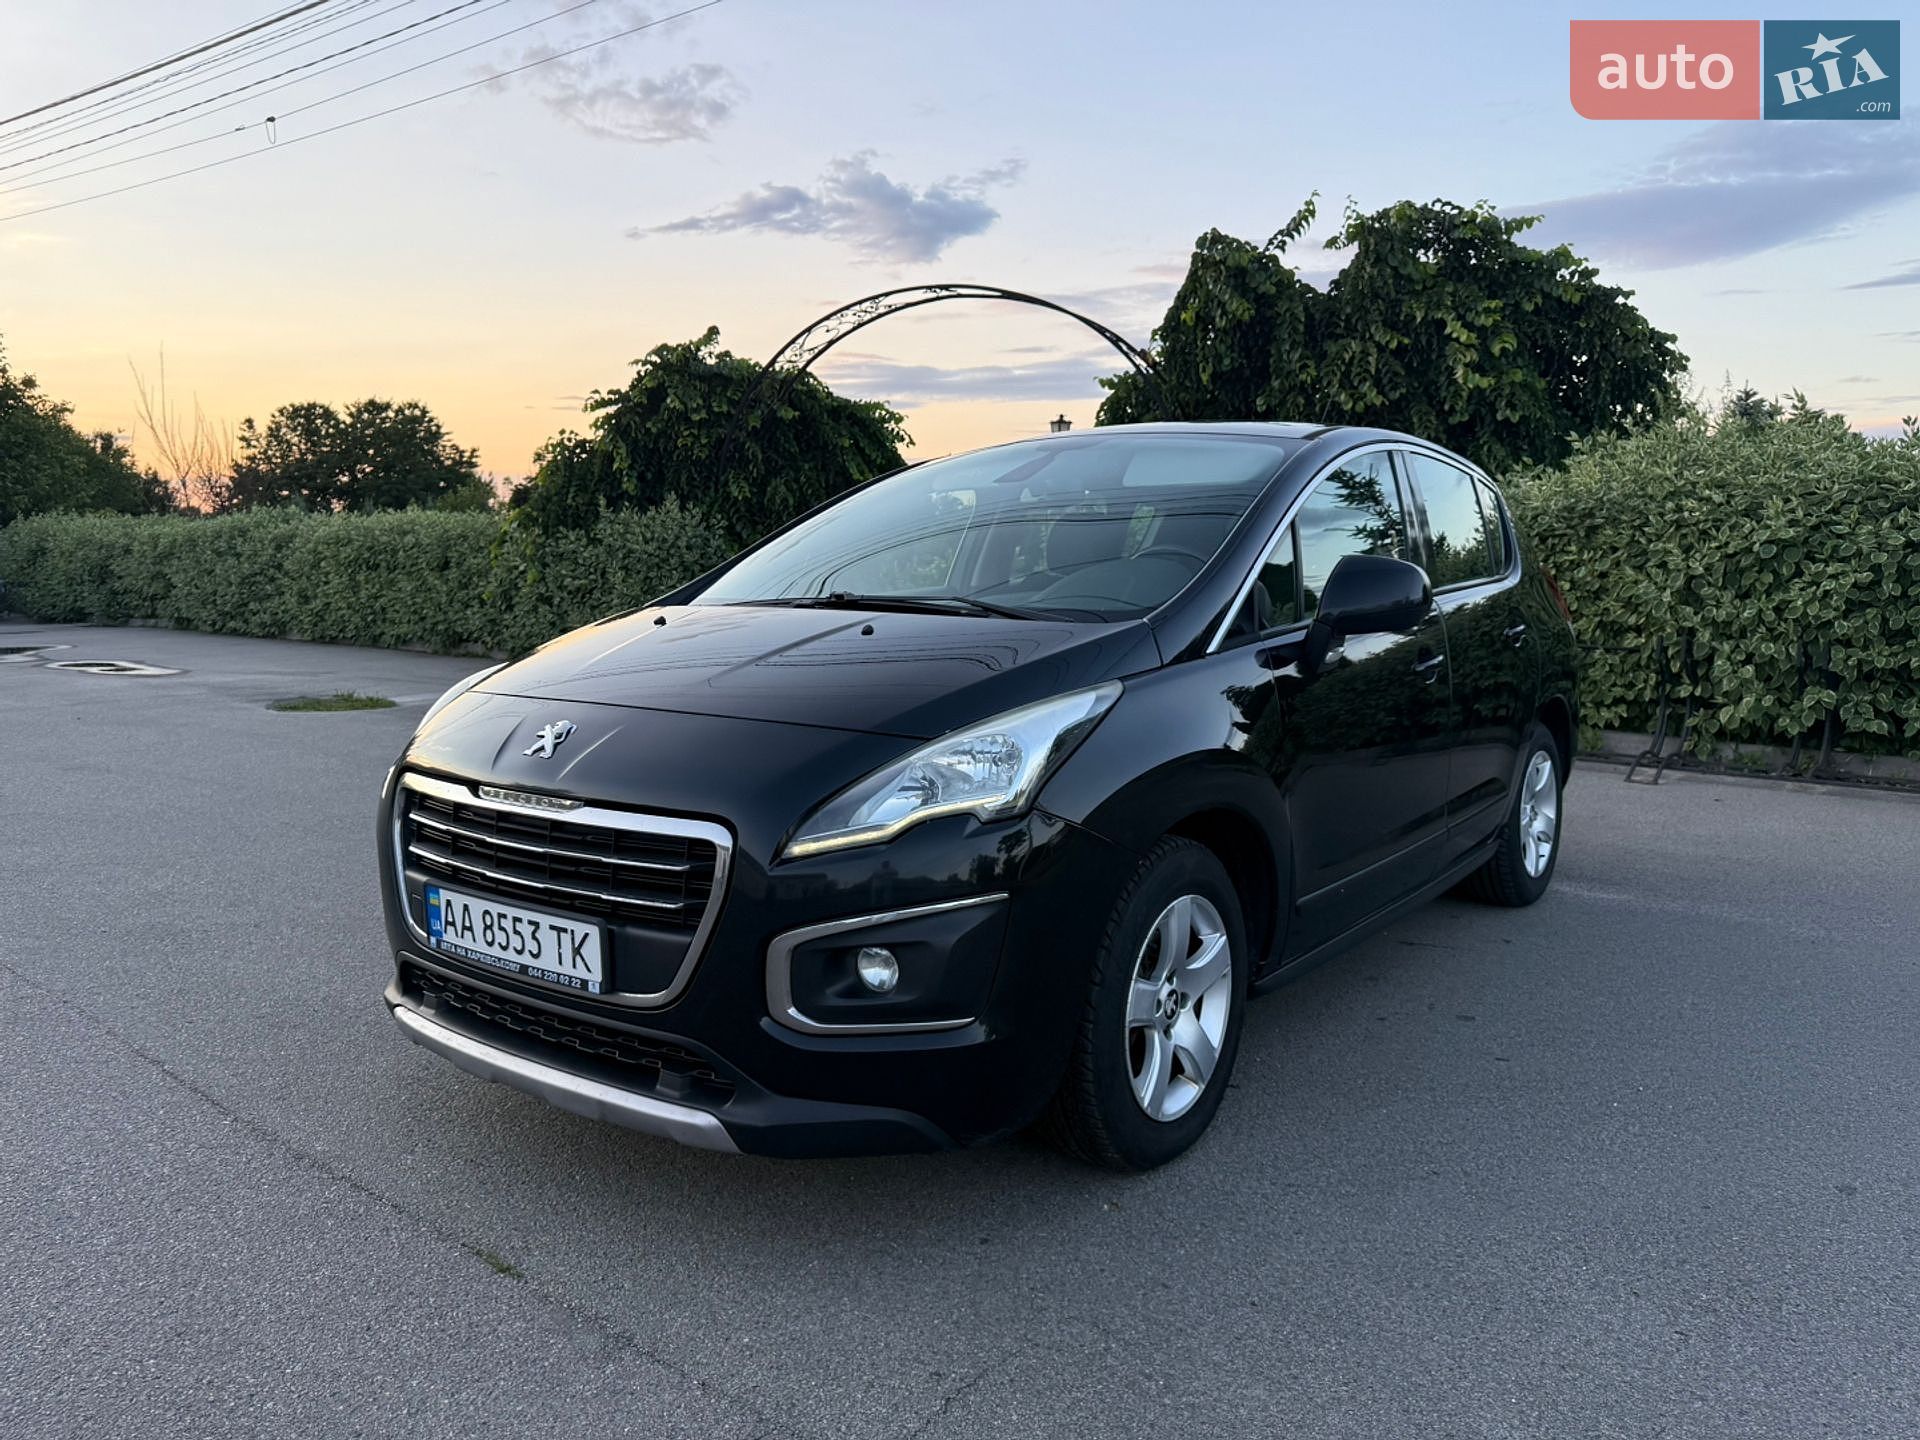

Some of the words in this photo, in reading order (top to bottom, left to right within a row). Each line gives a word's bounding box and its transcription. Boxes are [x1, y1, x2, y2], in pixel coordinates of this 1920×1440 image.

[431, 918, 441, 930] UA
[444, 898, 476, 943] AA
[482, 909, 542, 959] 8553
[548, 924, 592, 973] TK
